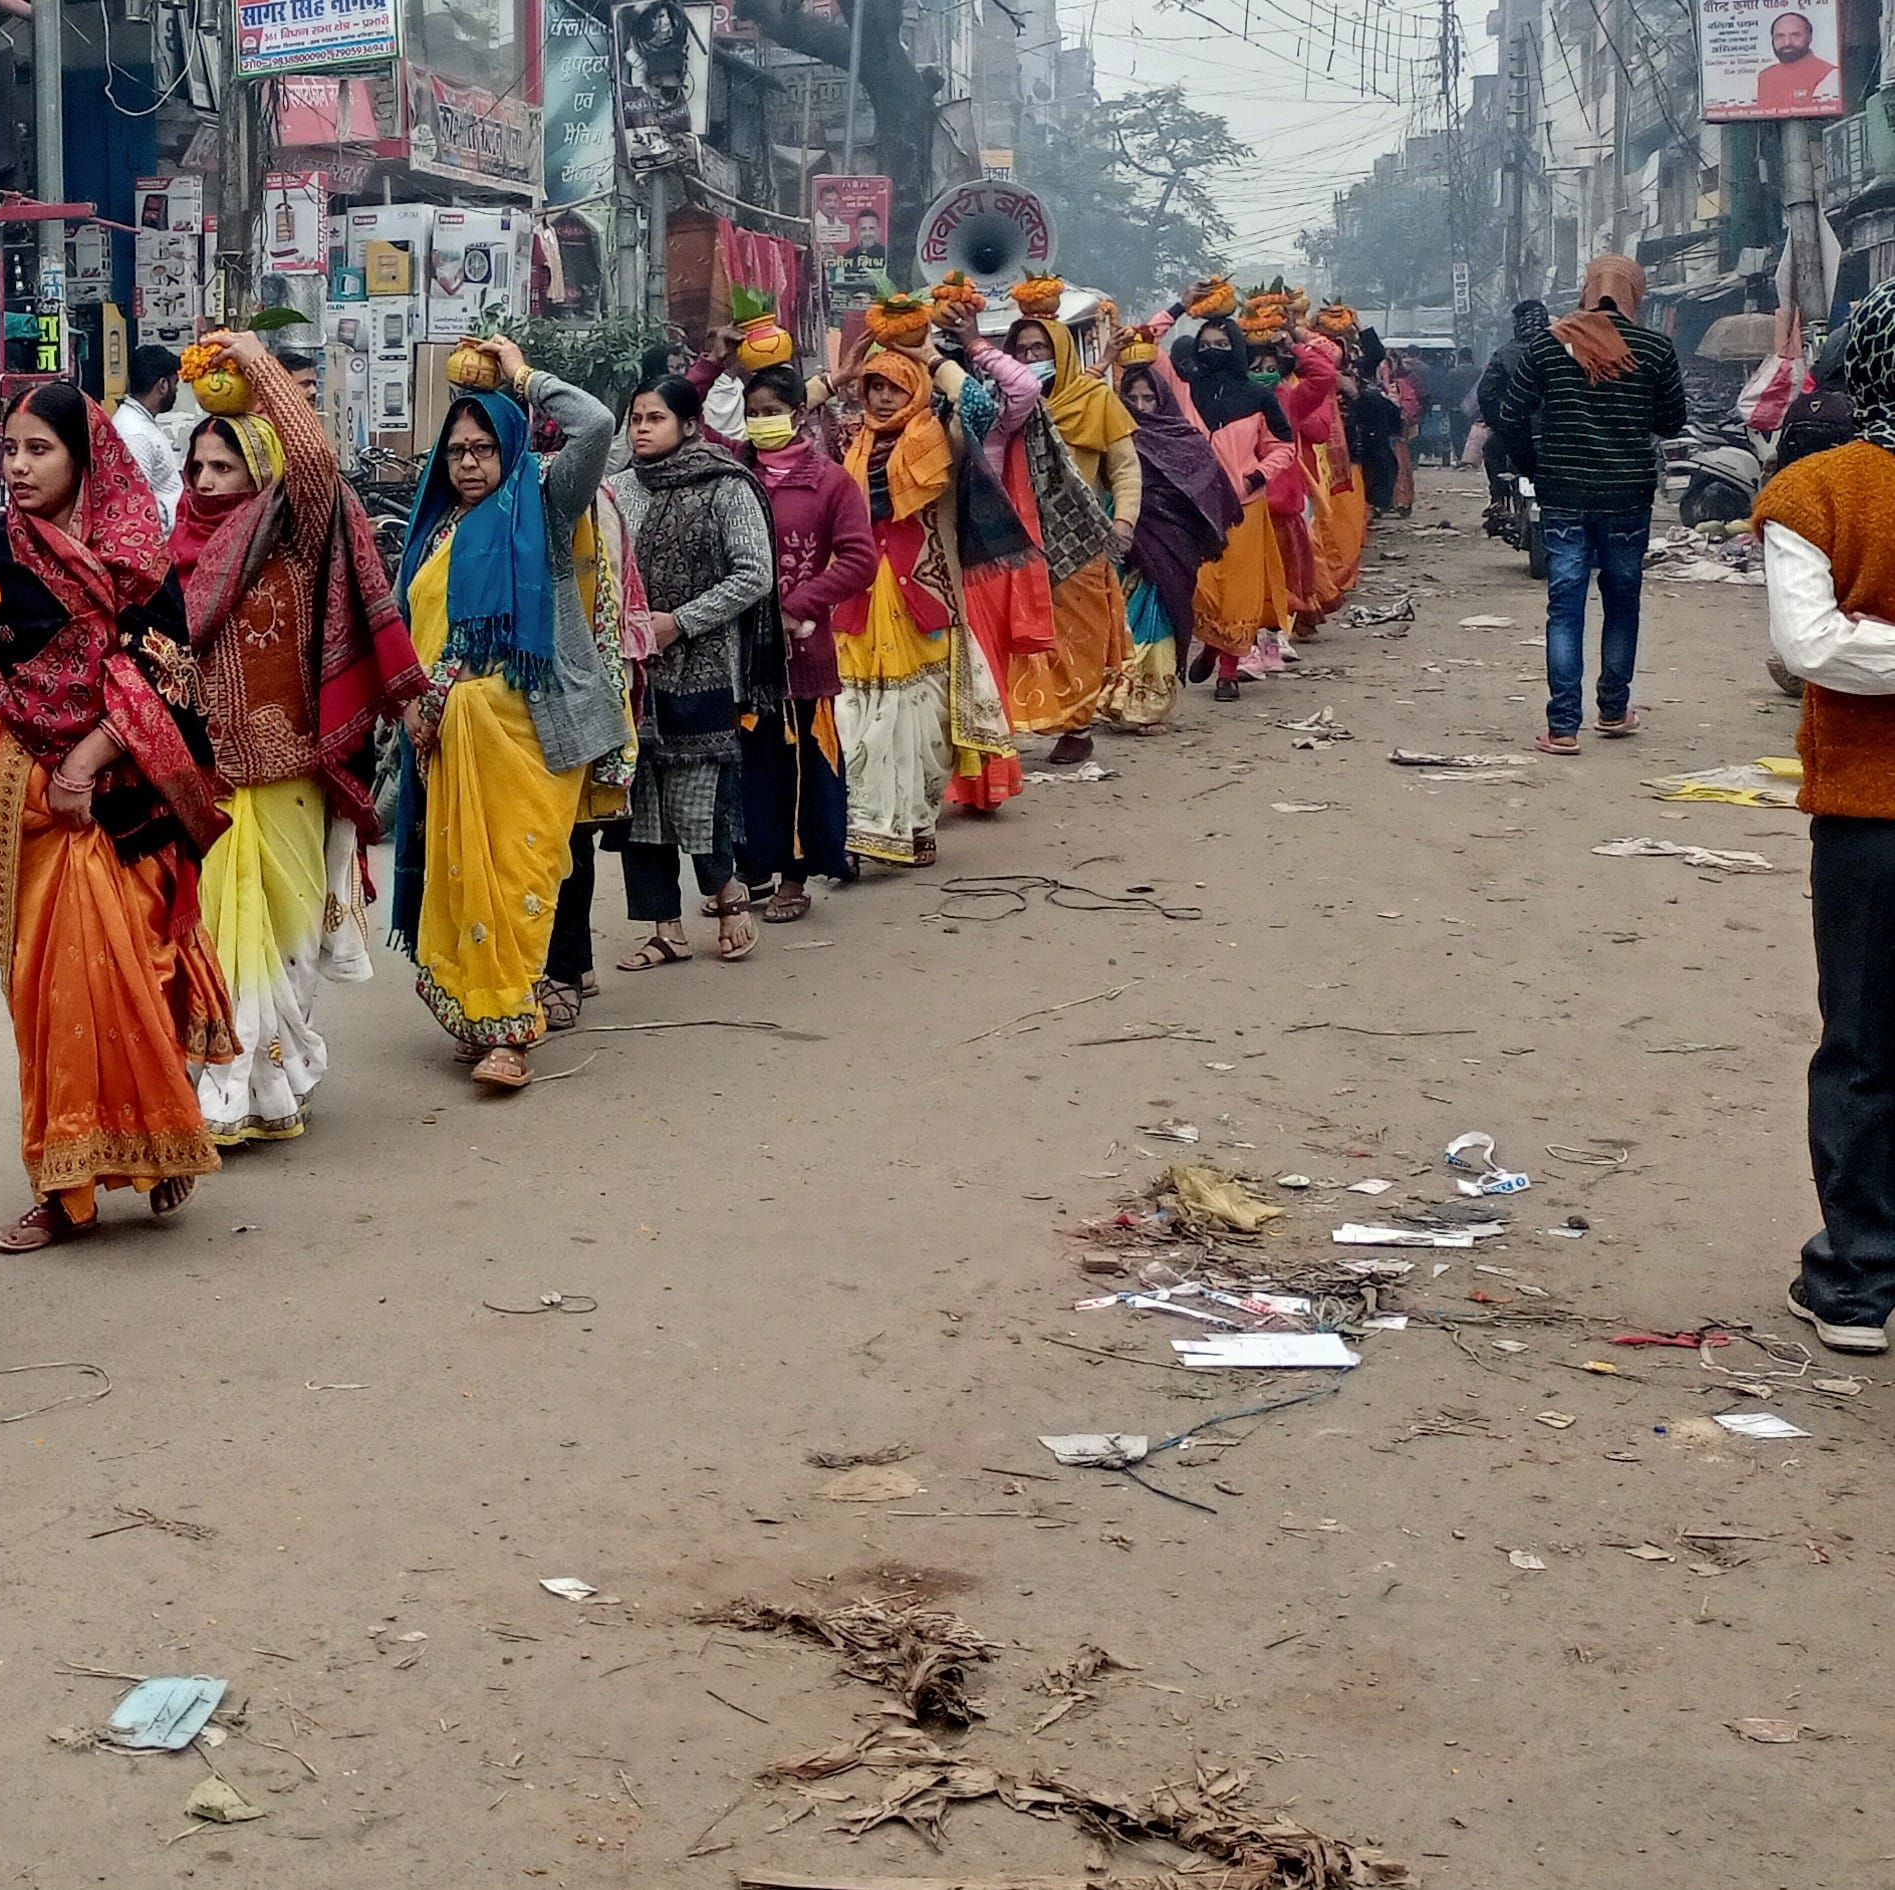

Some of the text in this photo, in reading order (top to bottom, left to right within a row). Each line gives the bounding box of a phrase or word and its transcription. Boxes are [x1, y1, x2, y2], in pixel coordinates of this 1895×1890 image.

[240, 1, 288, 27] सागर
[561, 55, 609, 81] दुपट्टा
[573, 86, 597, 112] एवं
[921, 188, 988, 264] तिवारी
